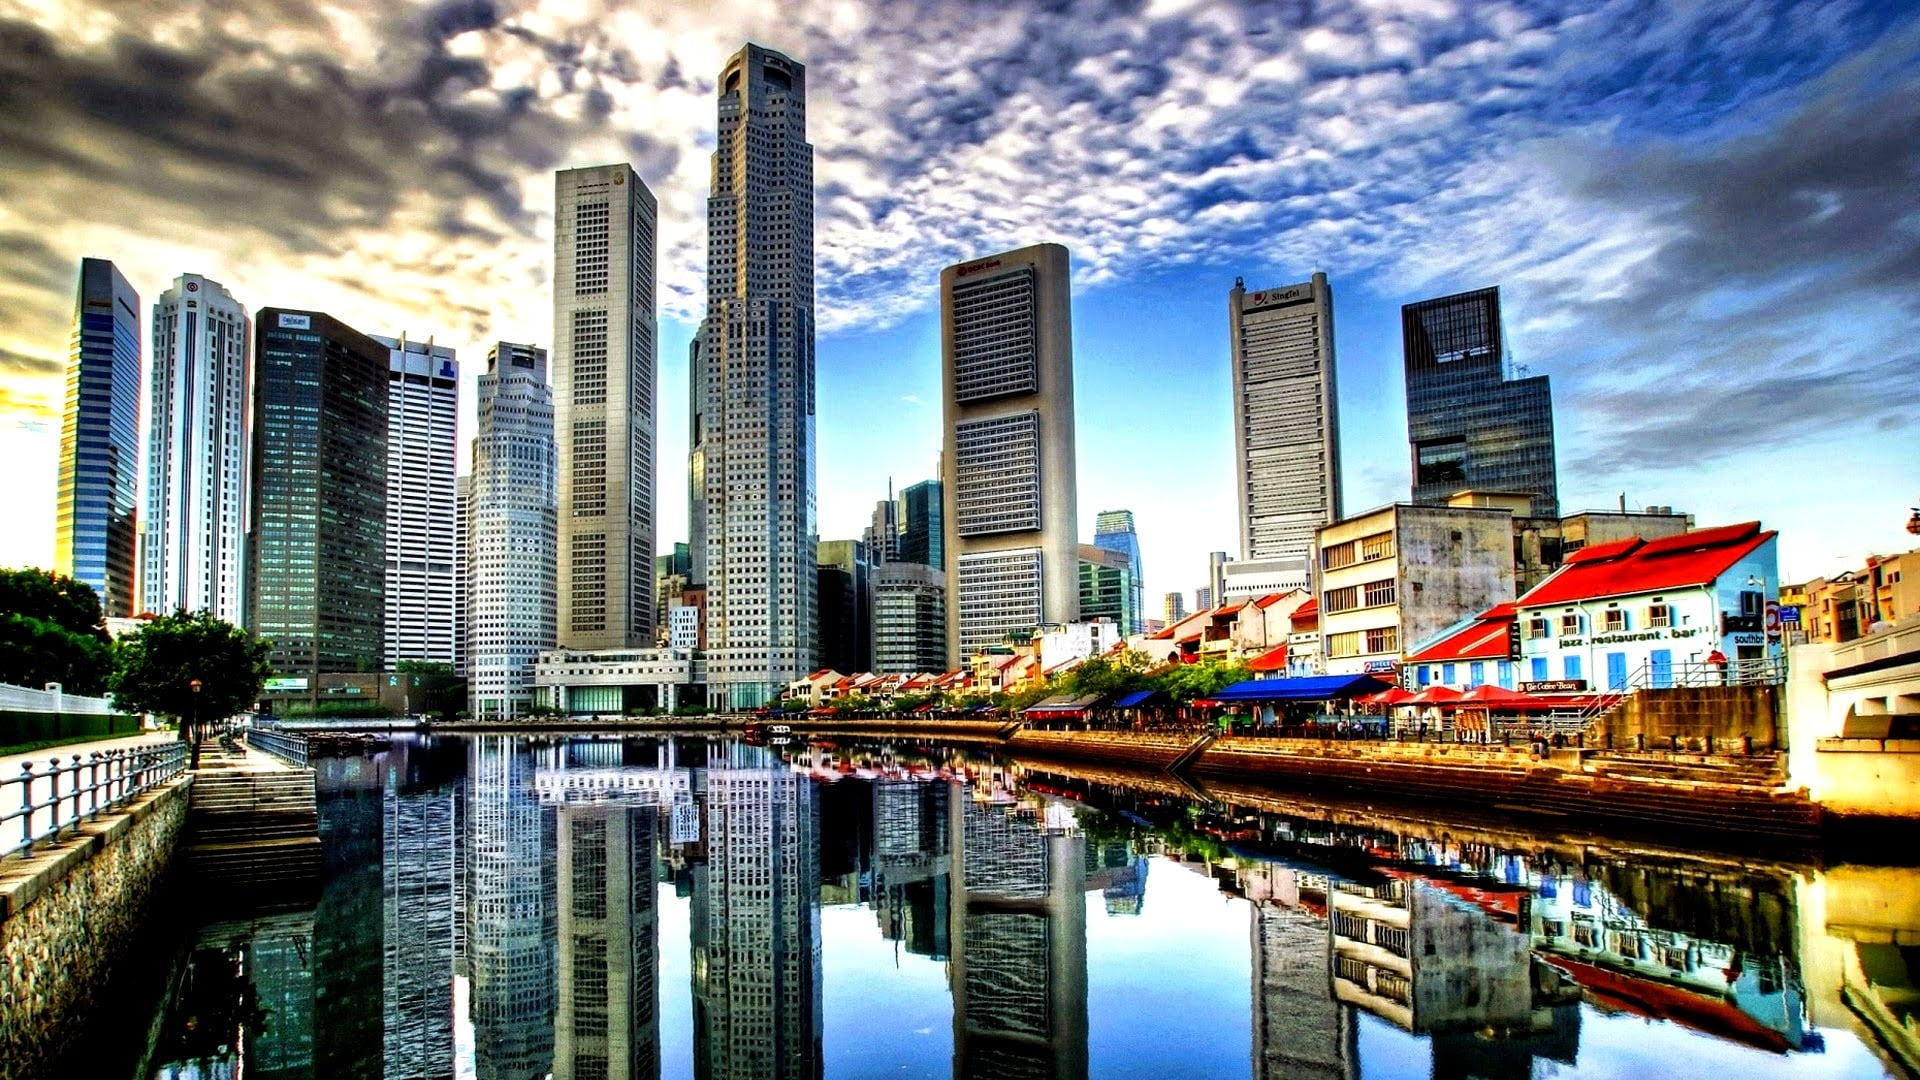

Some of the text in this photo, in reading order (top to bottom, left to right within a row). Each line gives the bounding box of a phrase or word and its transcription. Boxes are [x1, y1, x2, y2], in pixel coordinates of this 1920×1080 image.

[1272, 289, 1300, 301] SingTel
[1559, 629, 1696, 649] jazz restaurant bar
